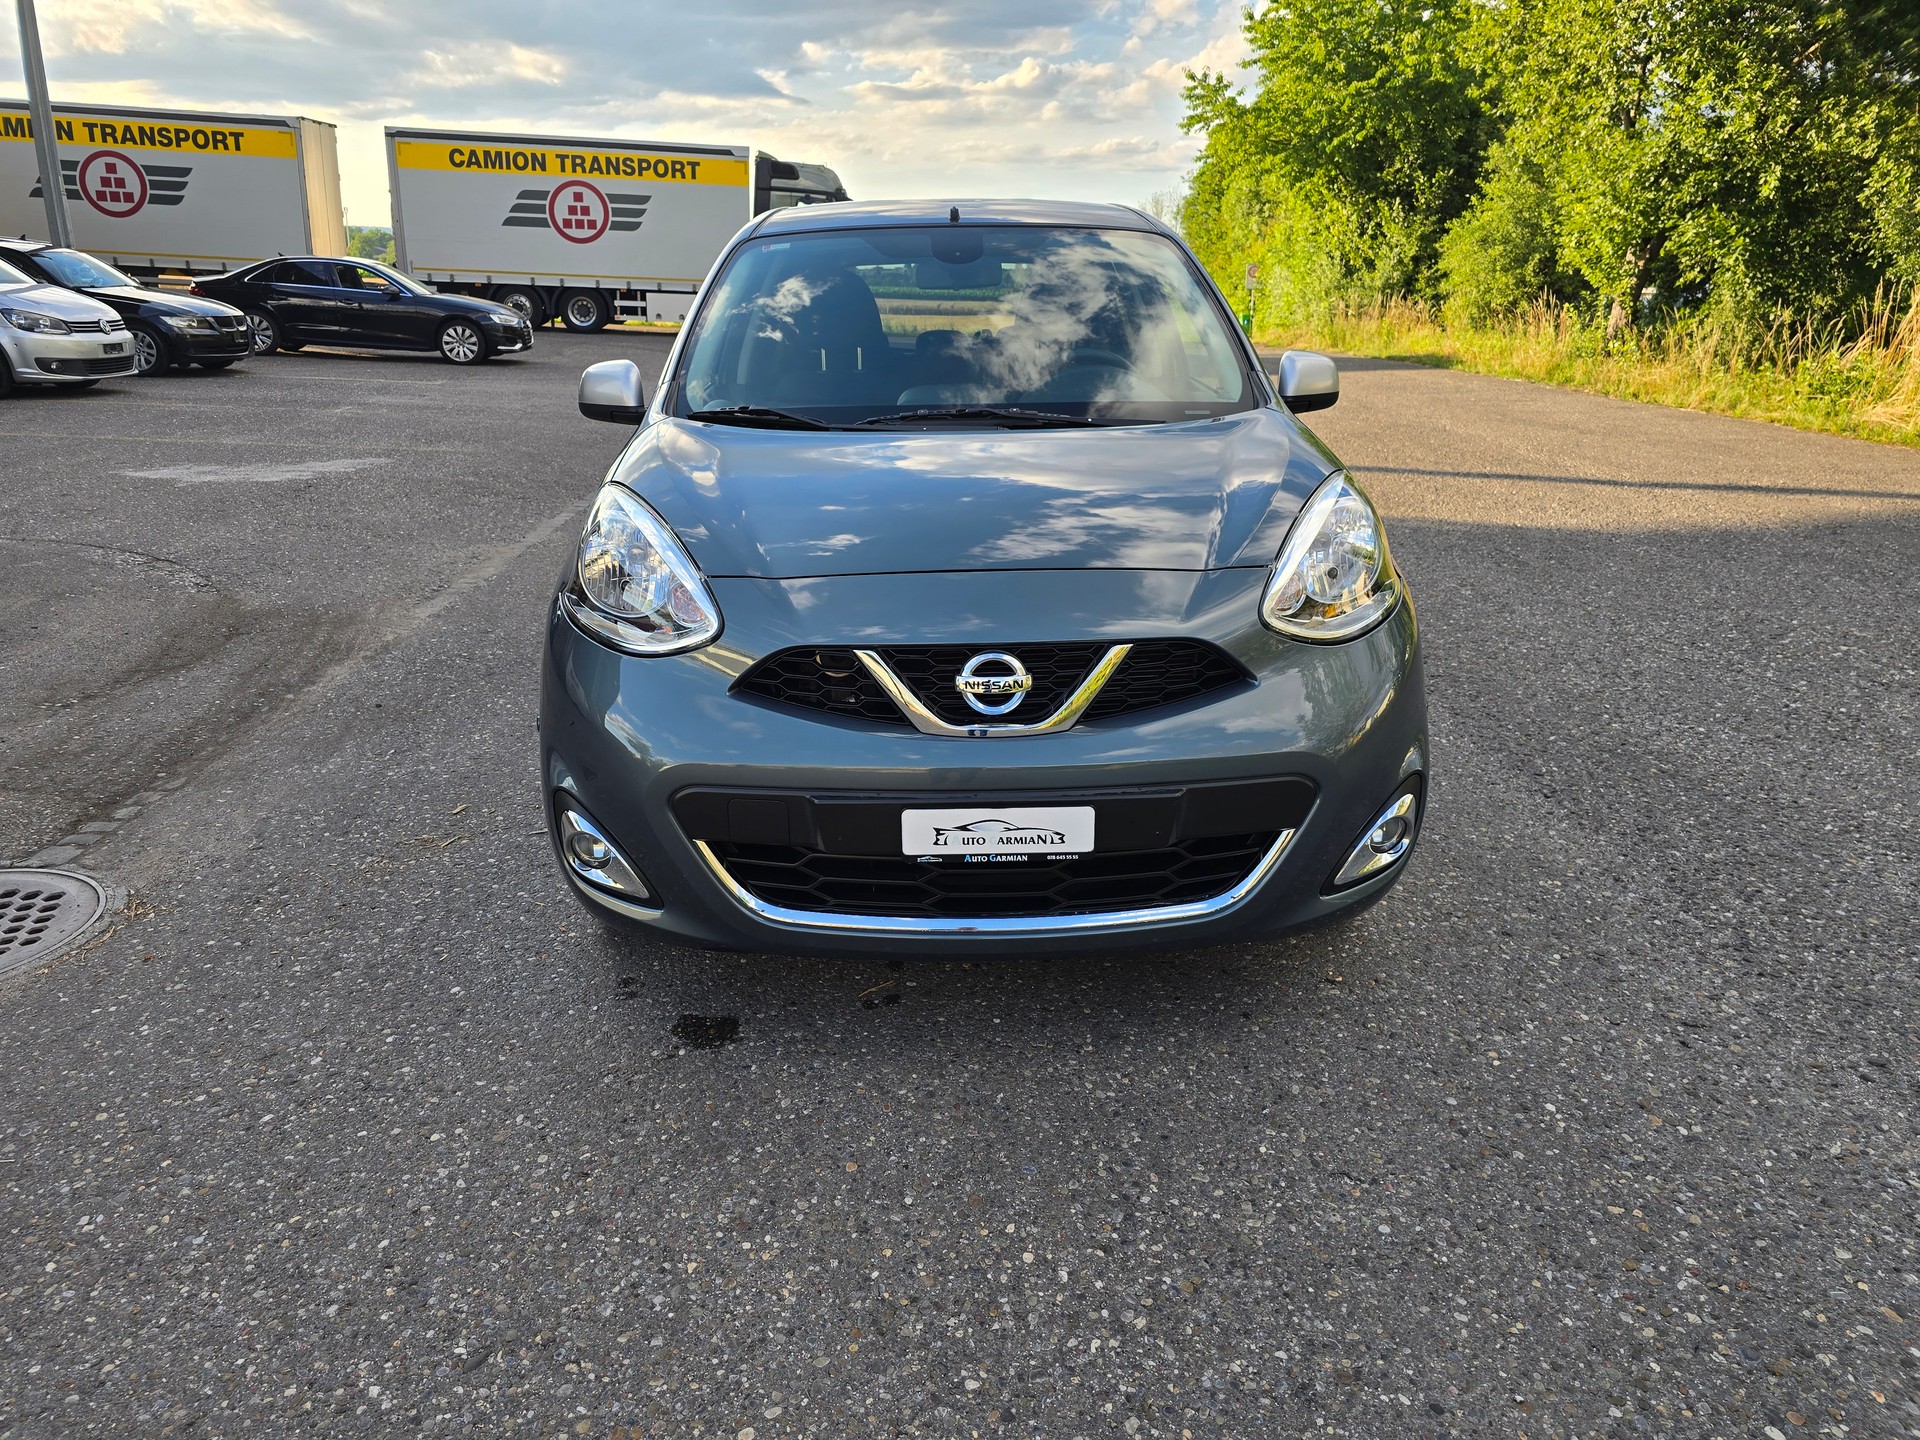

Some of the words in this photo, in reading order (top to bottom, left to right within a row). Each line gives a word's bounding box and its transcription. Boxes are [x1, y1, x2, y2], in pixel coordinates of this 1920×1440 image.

[0, 116, 74, 141] MIN
[82, 122, 244, 152] TRANSPORT
[448, 147, 547, 172] CAMION
[555, 153, 701, 180] TRANSPORT
[964, 680, 1024, 690] NISSAN
[964, 854, 988, 862] AUTO
[989, 854, 1028, 862] GARMIAN
